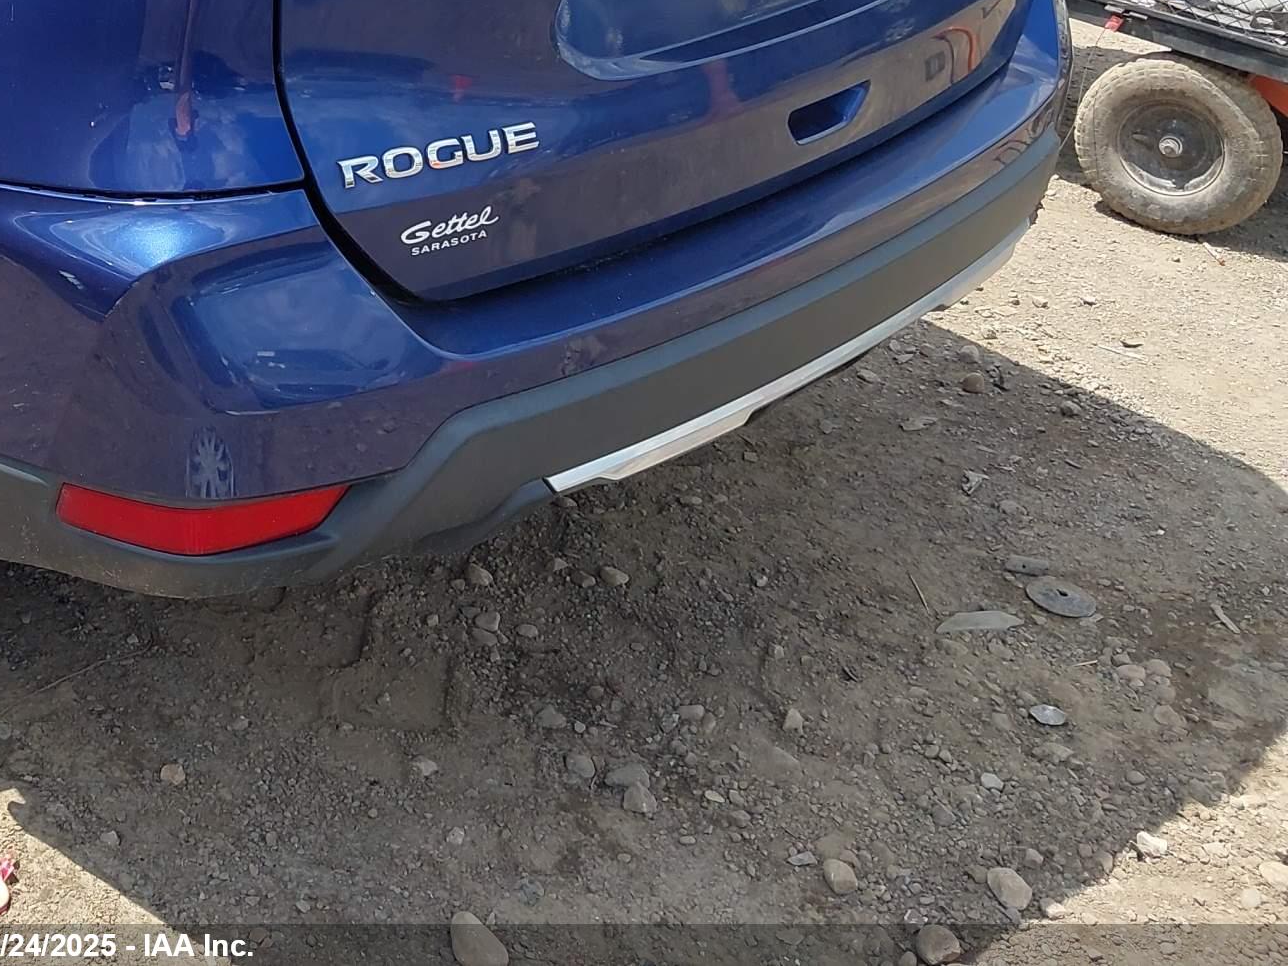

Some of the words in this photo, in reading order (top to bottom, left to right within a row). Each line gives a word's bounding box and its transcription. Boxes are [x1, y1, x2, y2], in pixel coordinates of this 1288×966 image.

[337, 121, 540, 189] ROGUE
[400, 205, 499, 244] Gettel
[411, 229, 488, 256] SARASOTA
